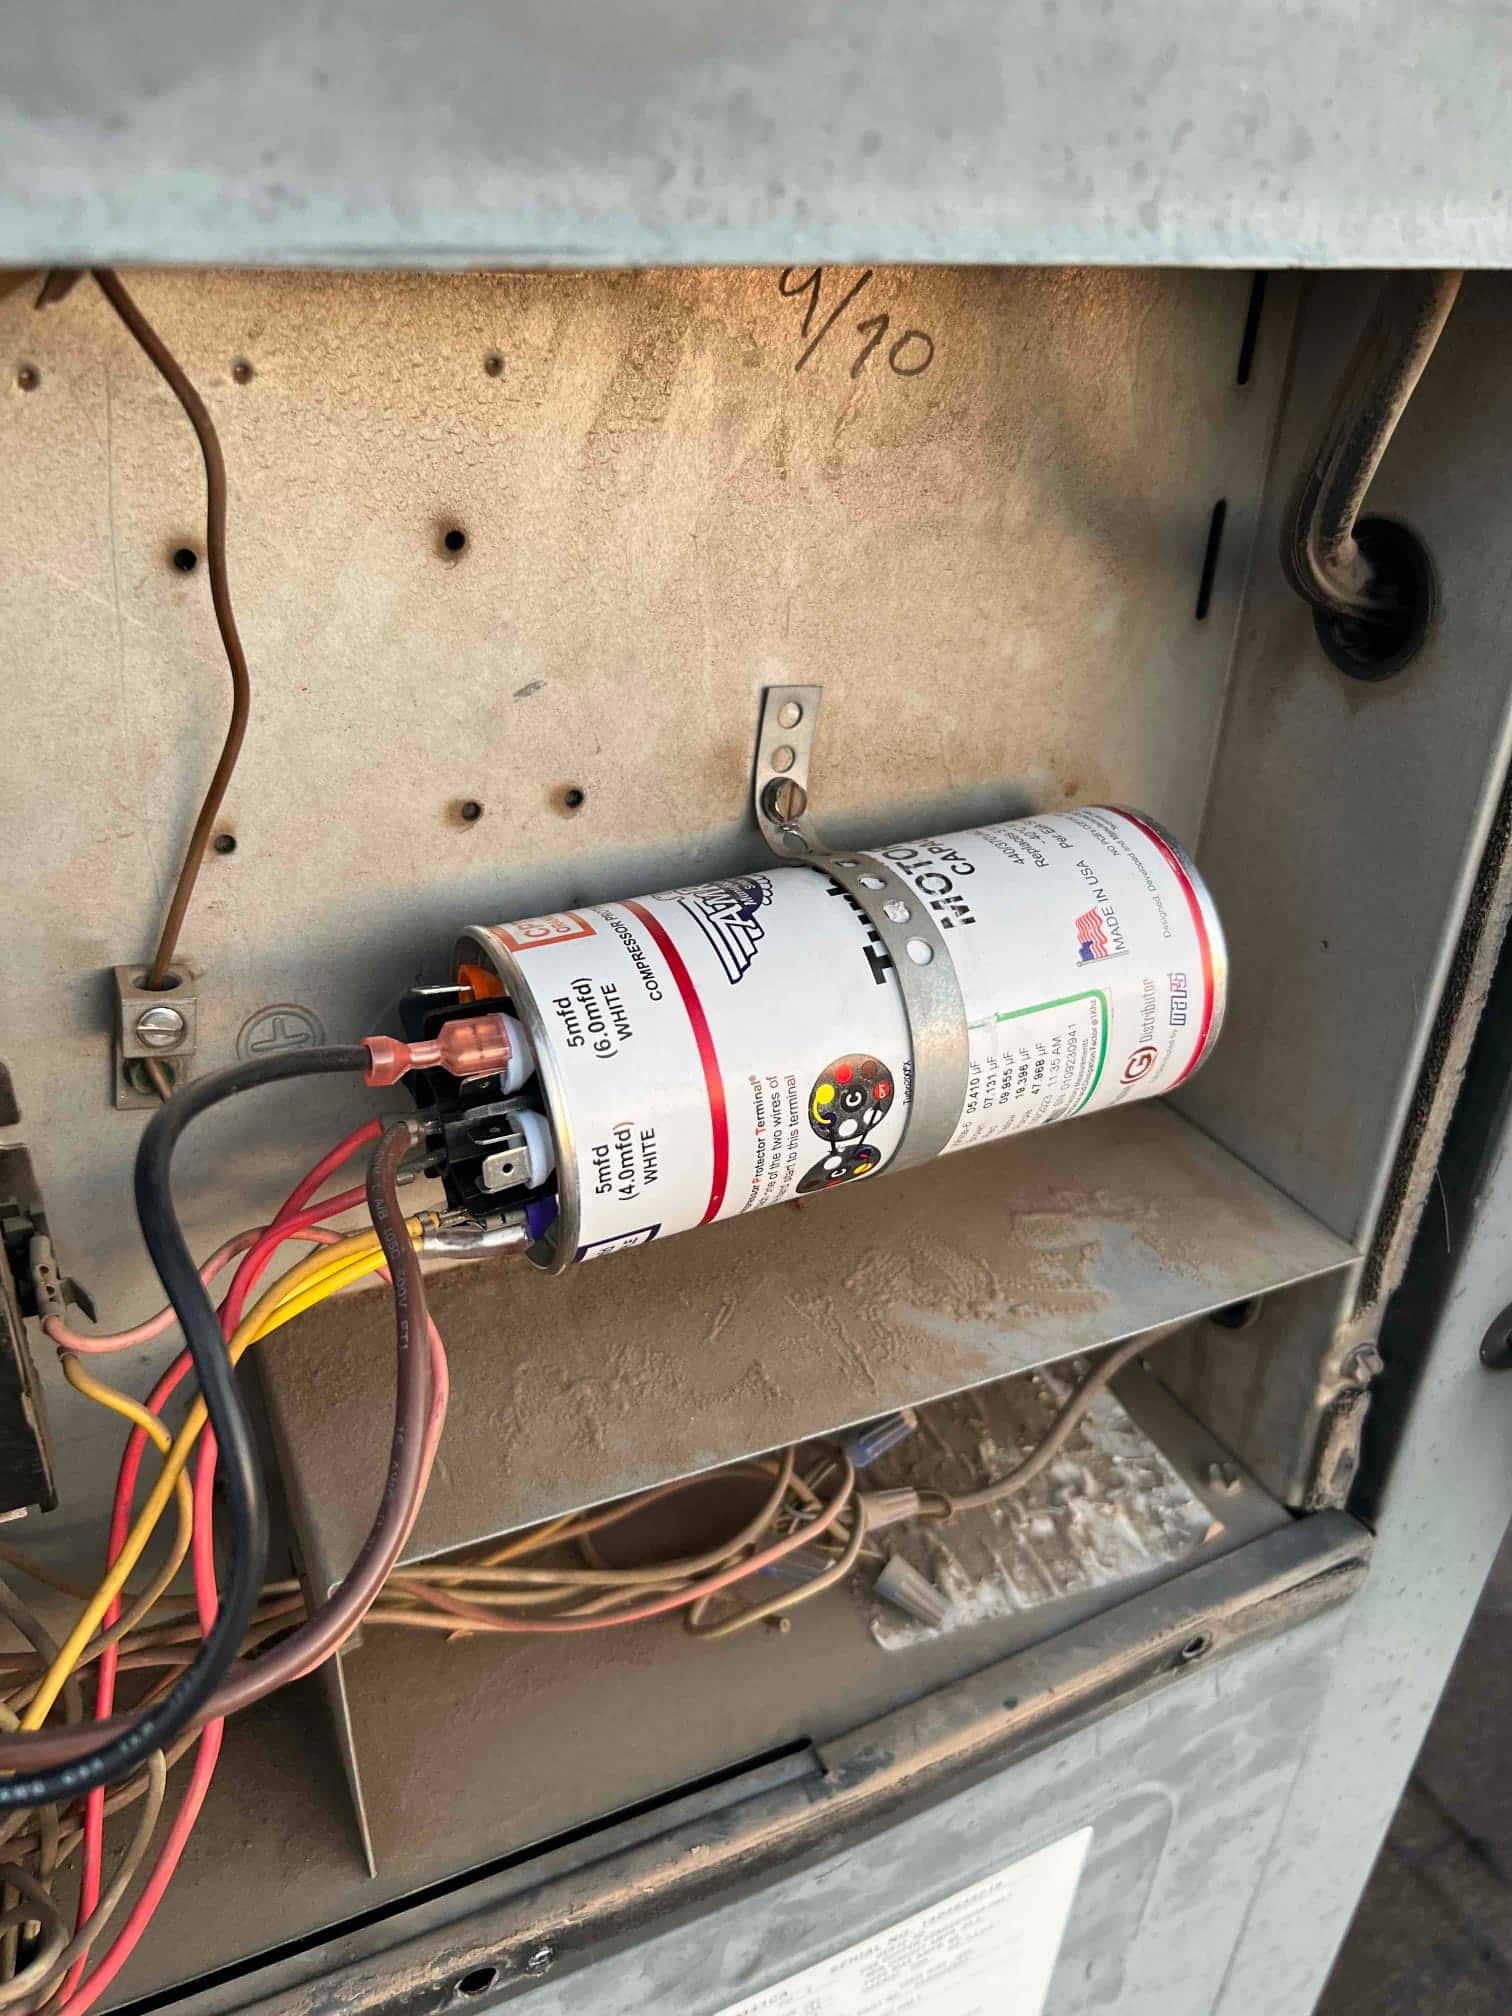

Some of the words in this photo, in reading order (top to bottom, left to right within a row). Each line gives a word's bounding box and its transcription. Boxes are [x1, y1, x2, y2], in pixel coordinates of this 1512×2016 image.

[917, 840, 976, 876] CAPA
[1076, 859, 1100, 886] USA
[880, 845, 977, 930] MOTO
[1093, 888, 1110, 903] IN
[1101, 904, 1127, 951] MADE
[609, 916, 663, 1001] COMPRESSOR
[552, 996, 586, 1048] 5mfd
[569, 977, 619, 1059] (6.0mfd)
[600, 983, 633, 1042] WHITE
[1052, 1035, 1062, 1056] AM
[766, 1075, 779, 1089] of
[784, 1074, 799, 1127] terminal
[966, 1077, 980, 1114] 05.410
[770, 1091, 782, 1128] wires
[640, 1127, 659, 1185] WHITE
[772, 1129, 783, 1152] two
[785, 1151, 798, 1163] to
[787, 1129, 799, 1150] this
[592, 1144, 613, 1194] 5mfd
[612, 1121, 641, 1201] (4.0mfd)
[752, 1138, 766, 1185] Protector
[770, 1152, 782, 1170] the
